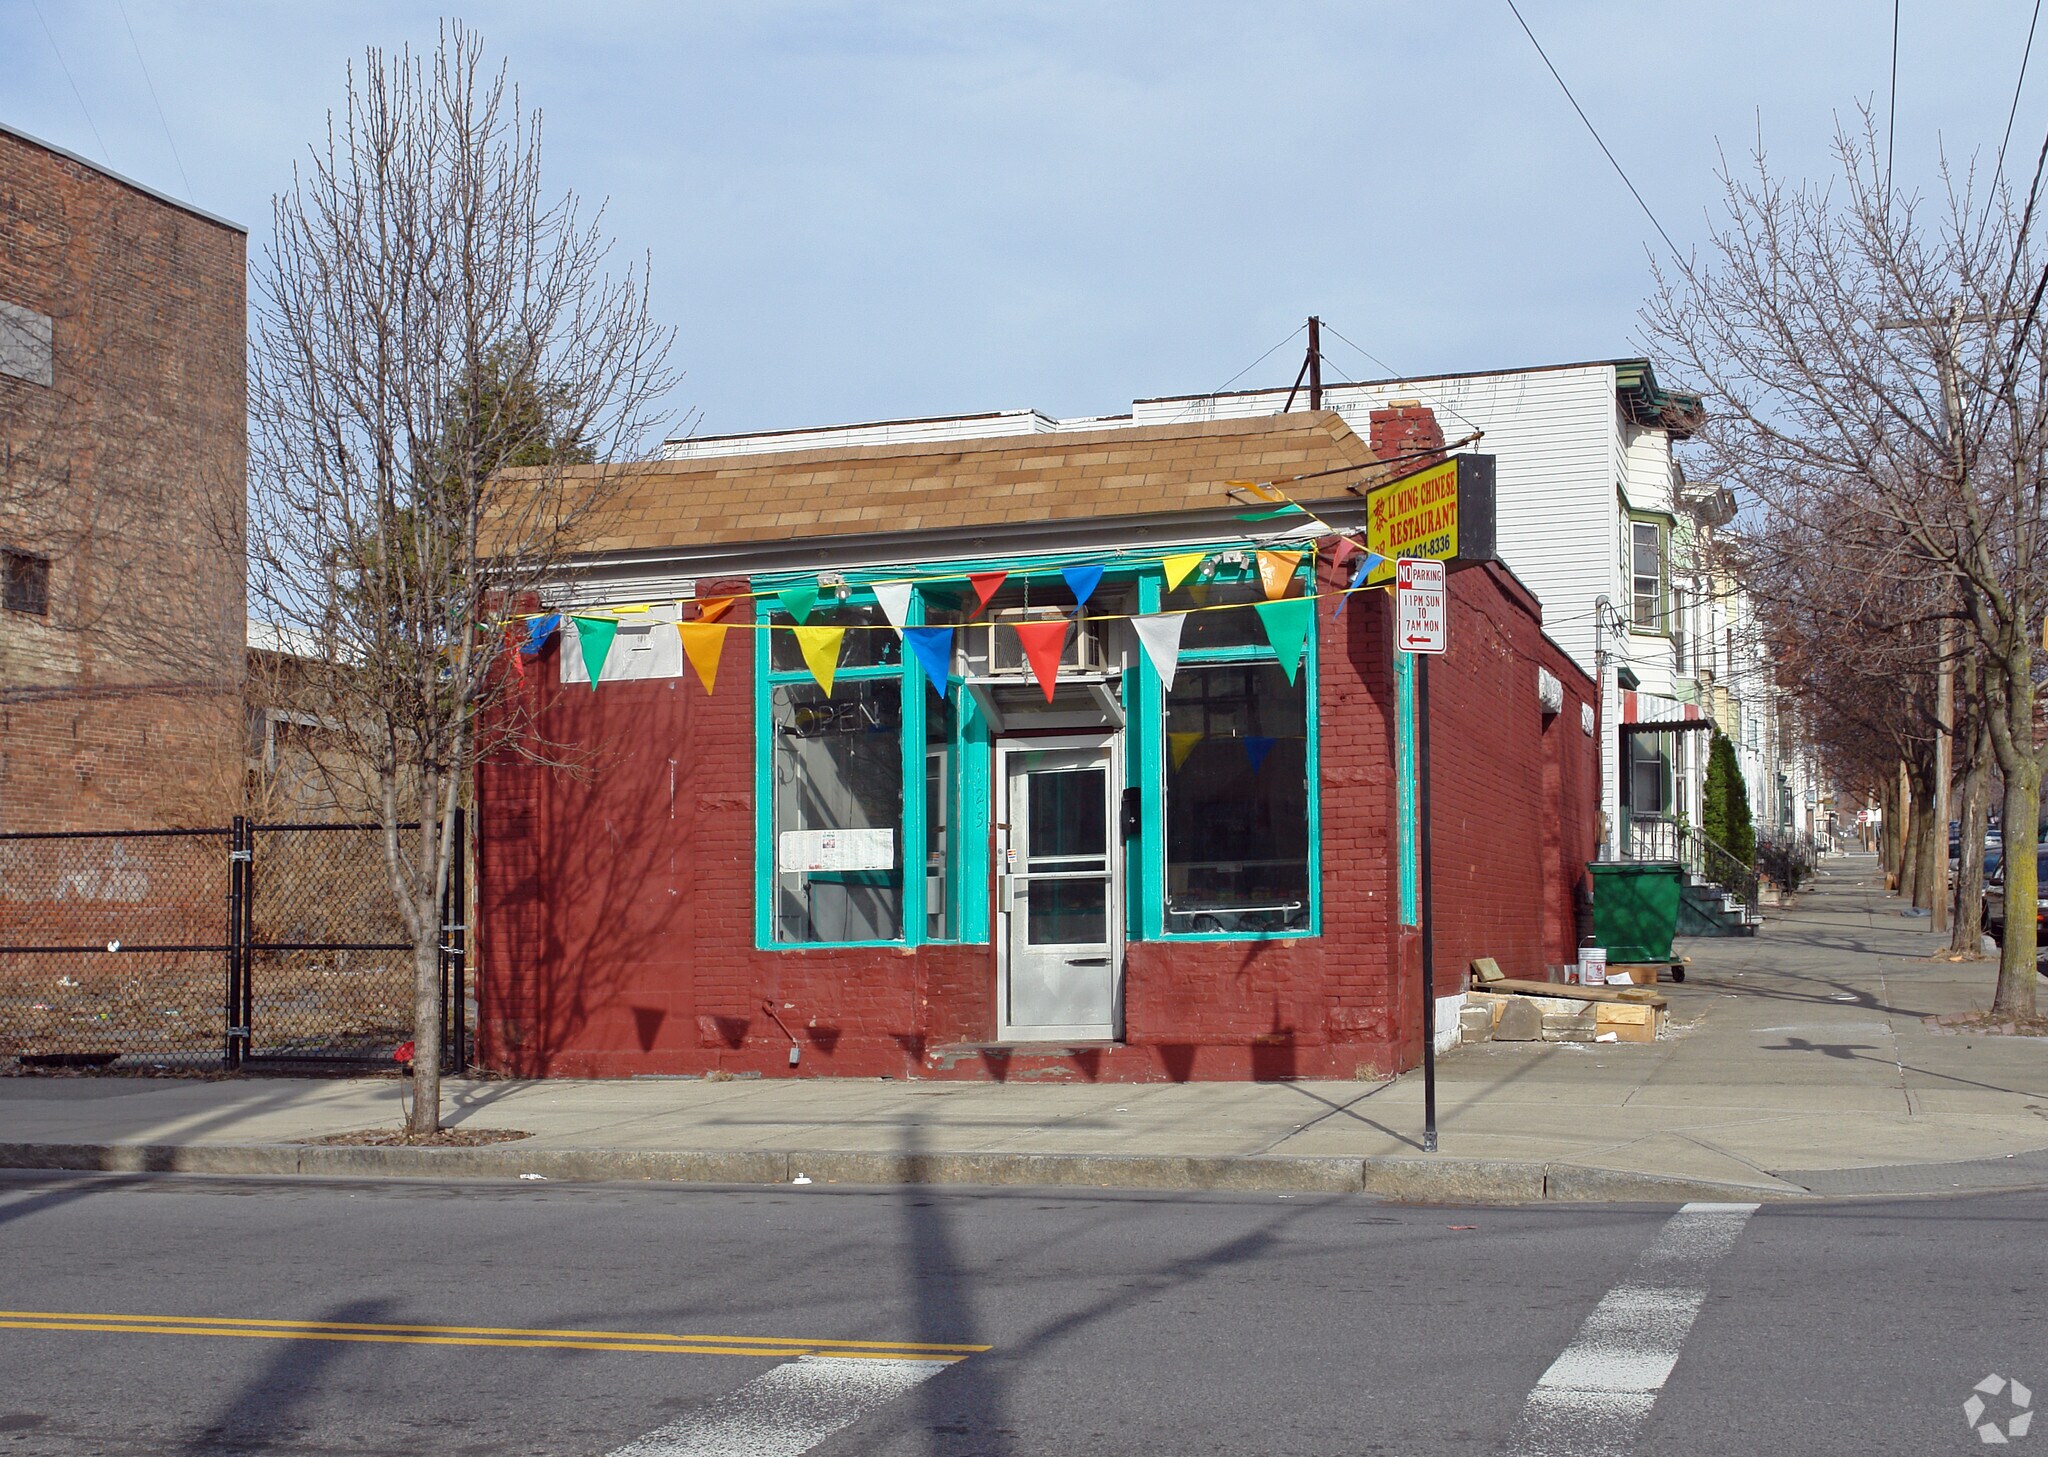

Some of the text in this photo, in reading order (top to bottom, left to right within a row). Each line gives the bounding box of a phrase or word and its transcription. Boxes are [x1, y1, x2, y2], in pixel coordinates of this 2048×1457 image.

[1388, 471, 1455, 519] LI MING CHINESE
[1389, 501, 1456, 547] RESTAURANT
[1399, 565, 1441, 582] NO PARKING
[1404, 595, 1440, 607] 11PM SUN
[1418, 607, 1427, 619] TO
[1406, 620, 1439, 632] 7AM MON
[795, 701, 880, 737] OPEN
